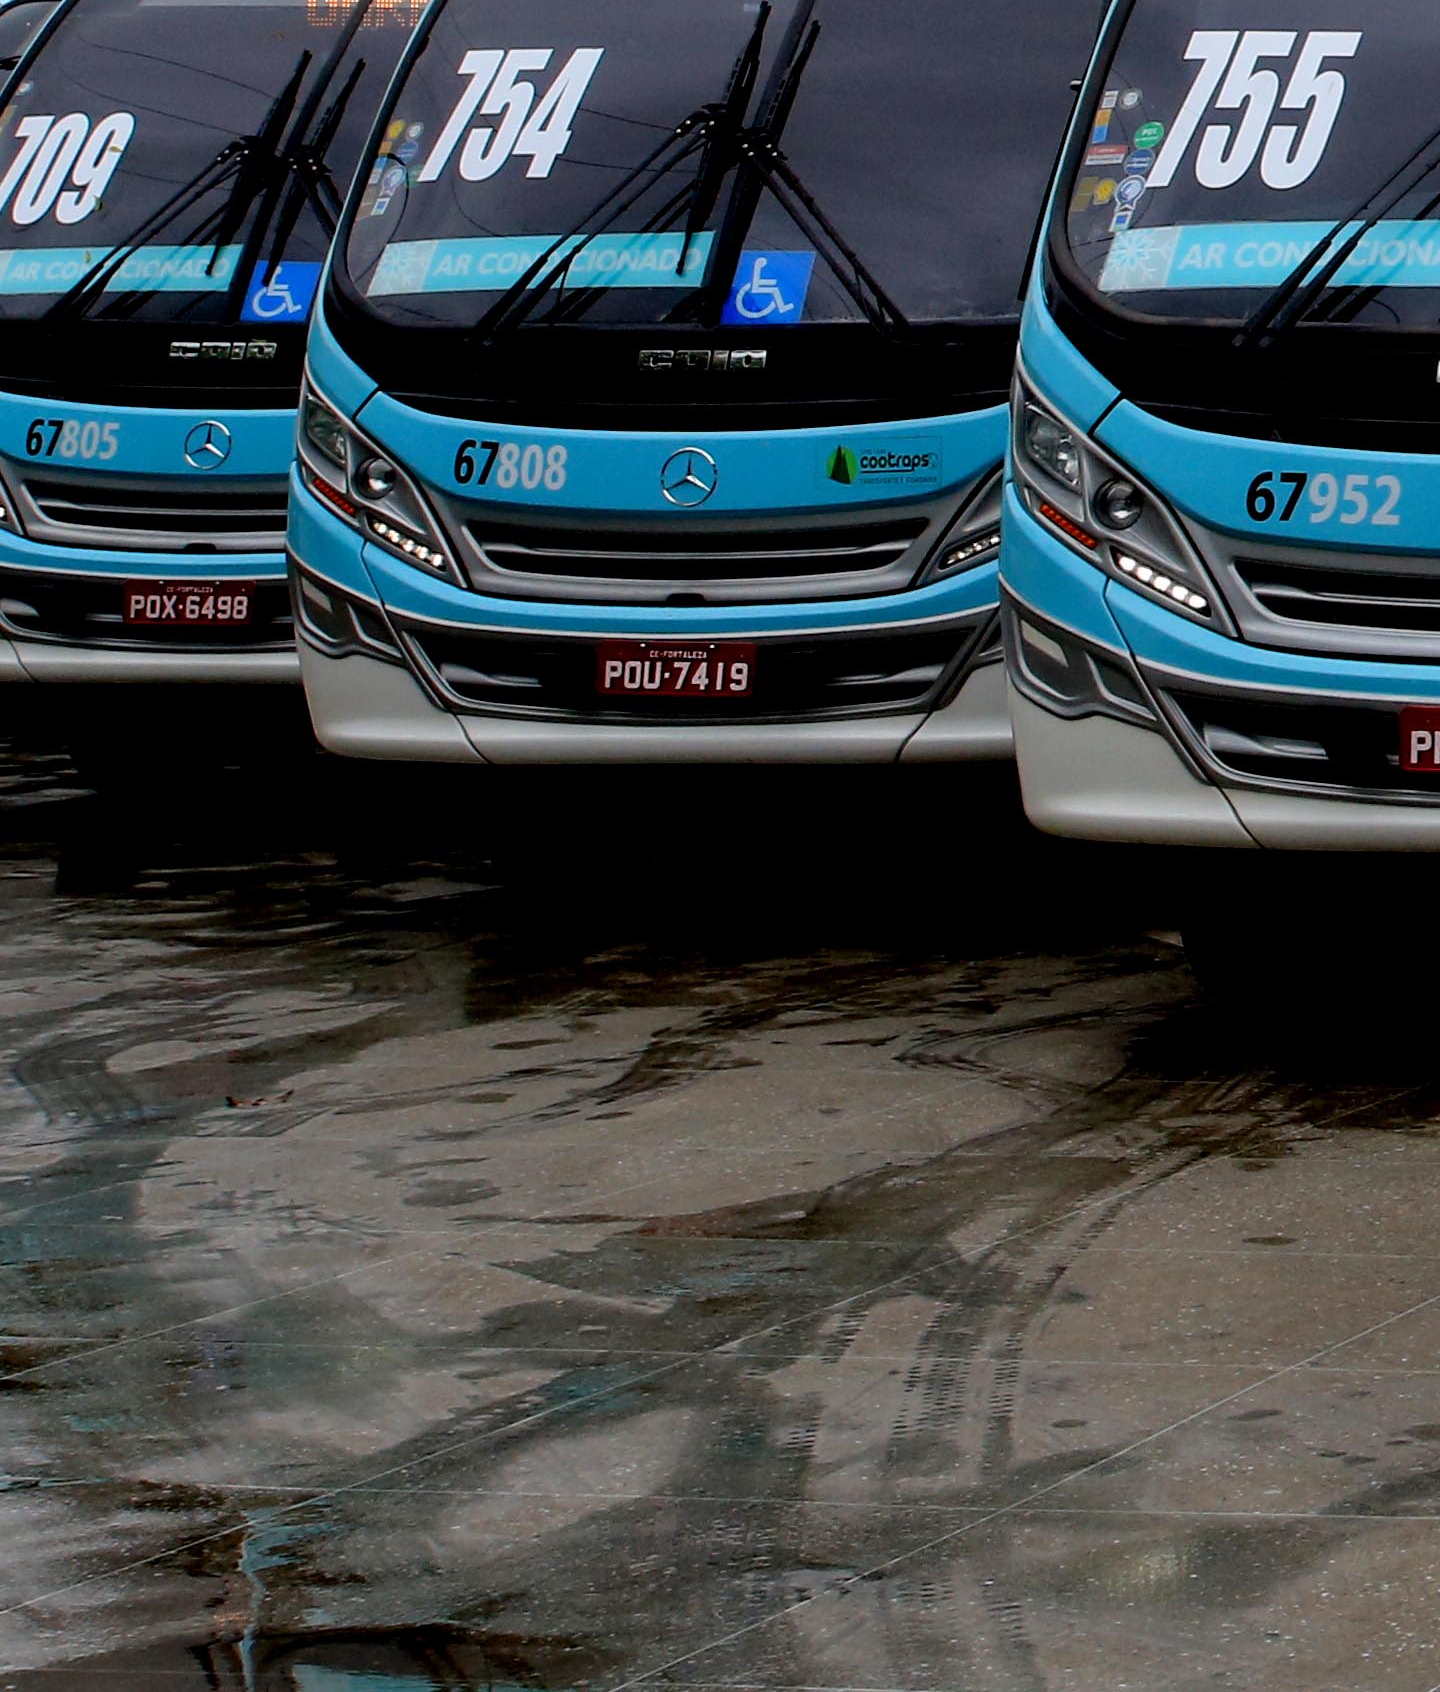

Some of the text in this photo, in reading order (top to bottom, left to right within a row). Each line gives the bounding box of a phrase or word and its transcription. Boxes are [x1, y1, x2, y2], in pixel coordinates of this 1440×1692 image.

[417, 47, 605, 182] 754
[1146, 30, 1363, 190] 755
[0, 112, 136, 225] 709
[12, 262, 41, 280] AR
[433, 252, 470, 276] AR
[1178, 242, 1225, 269] AR
[26, 418, 120, 459] 67805
[860, 452, 929, 471] cootraps
[453, 438, 568, 491] 67808
[1245, 471, 1402, 526] 67952
